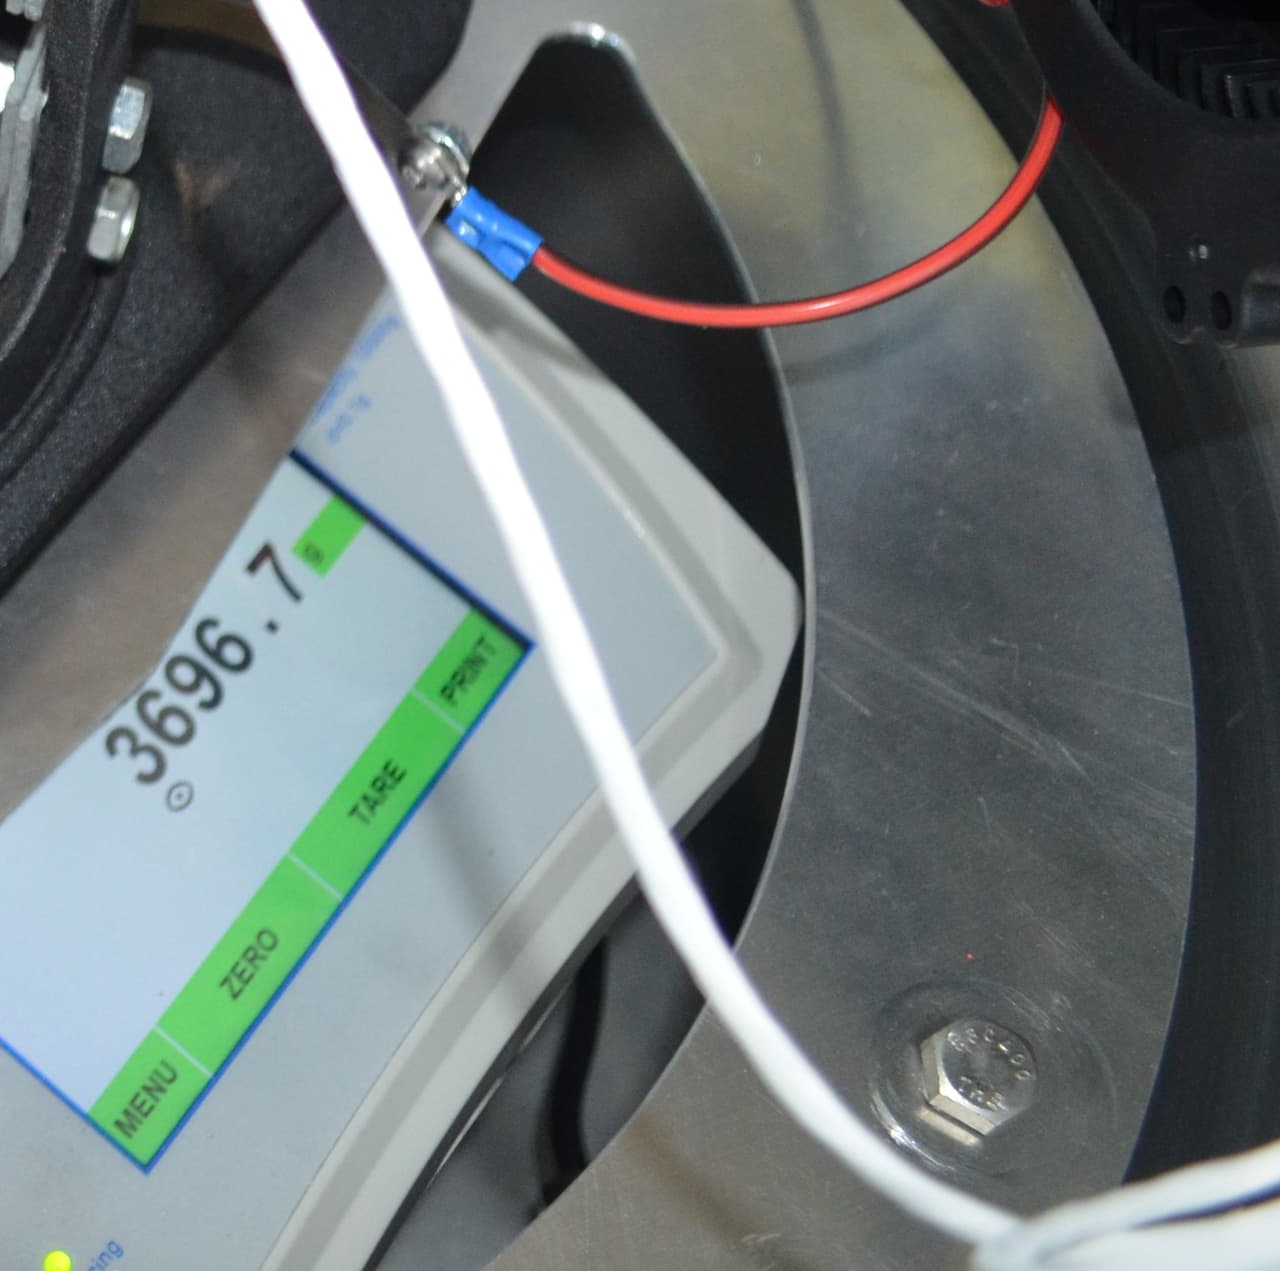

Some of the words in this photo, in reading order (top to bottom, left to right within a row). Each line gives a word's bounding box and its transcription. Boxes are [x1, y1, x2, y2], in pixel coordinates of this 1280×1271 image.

[105, 541, 302, 785] 3696.7
[440, 634, 497, 707] PRINT
[348, 759, 407, 826] TARE
[219, 928, 279, 1000] ZERO
[113, 1058, 178, 1139] MENU
